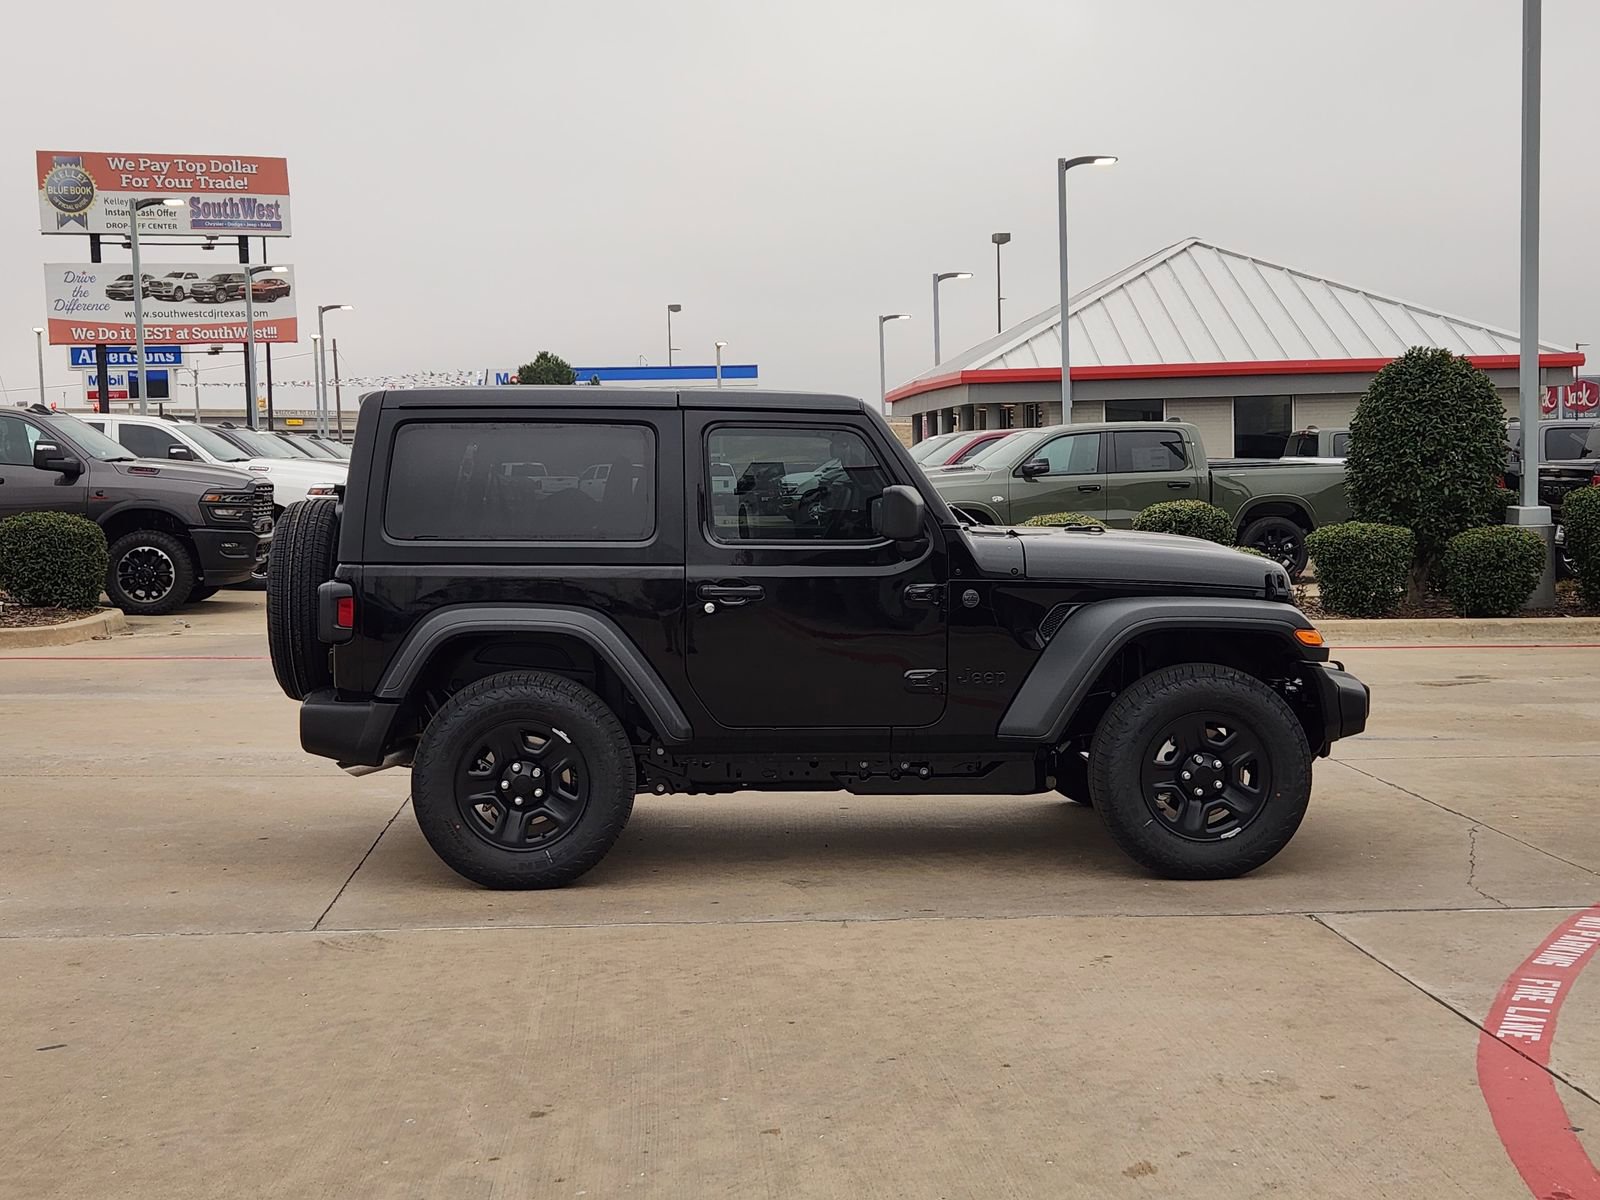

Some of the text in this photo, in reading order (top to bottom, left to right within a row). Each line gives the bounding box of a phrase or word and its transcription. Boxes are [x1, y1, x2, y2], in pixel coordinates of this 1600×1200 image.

[106, 157, 258, 175] We Pay Top Dollar
[52, 169, 88, 183] KELLEY
[120, 174, 248, 189] For Your Trade!
[48, 186, 92, 195] BLUE BOOK
[104, 197, 128, 206] Kelley
[189, 196, 281, 220] SouthWest
[105, 208, 131, 216] Instan
[156, 209, 177, 217] Offer
[63, 270, 96, 283] Drive
[71, 285, 90, 298] the
[54, 298, 111, 314] Difference
[71, 326, 278, 340] We Do it EST at SouthWst!!!
[88, 375, 123, 386] Mbil
[1564, 383, 1599, 407] Jack
[957, 667, 1007, 686] Jeep
[1532, 929, 1600, 968] PARKING
[1511, 978, 1562, 1004] FIRE
[1495, 1006, 1551, 1041] LANE
